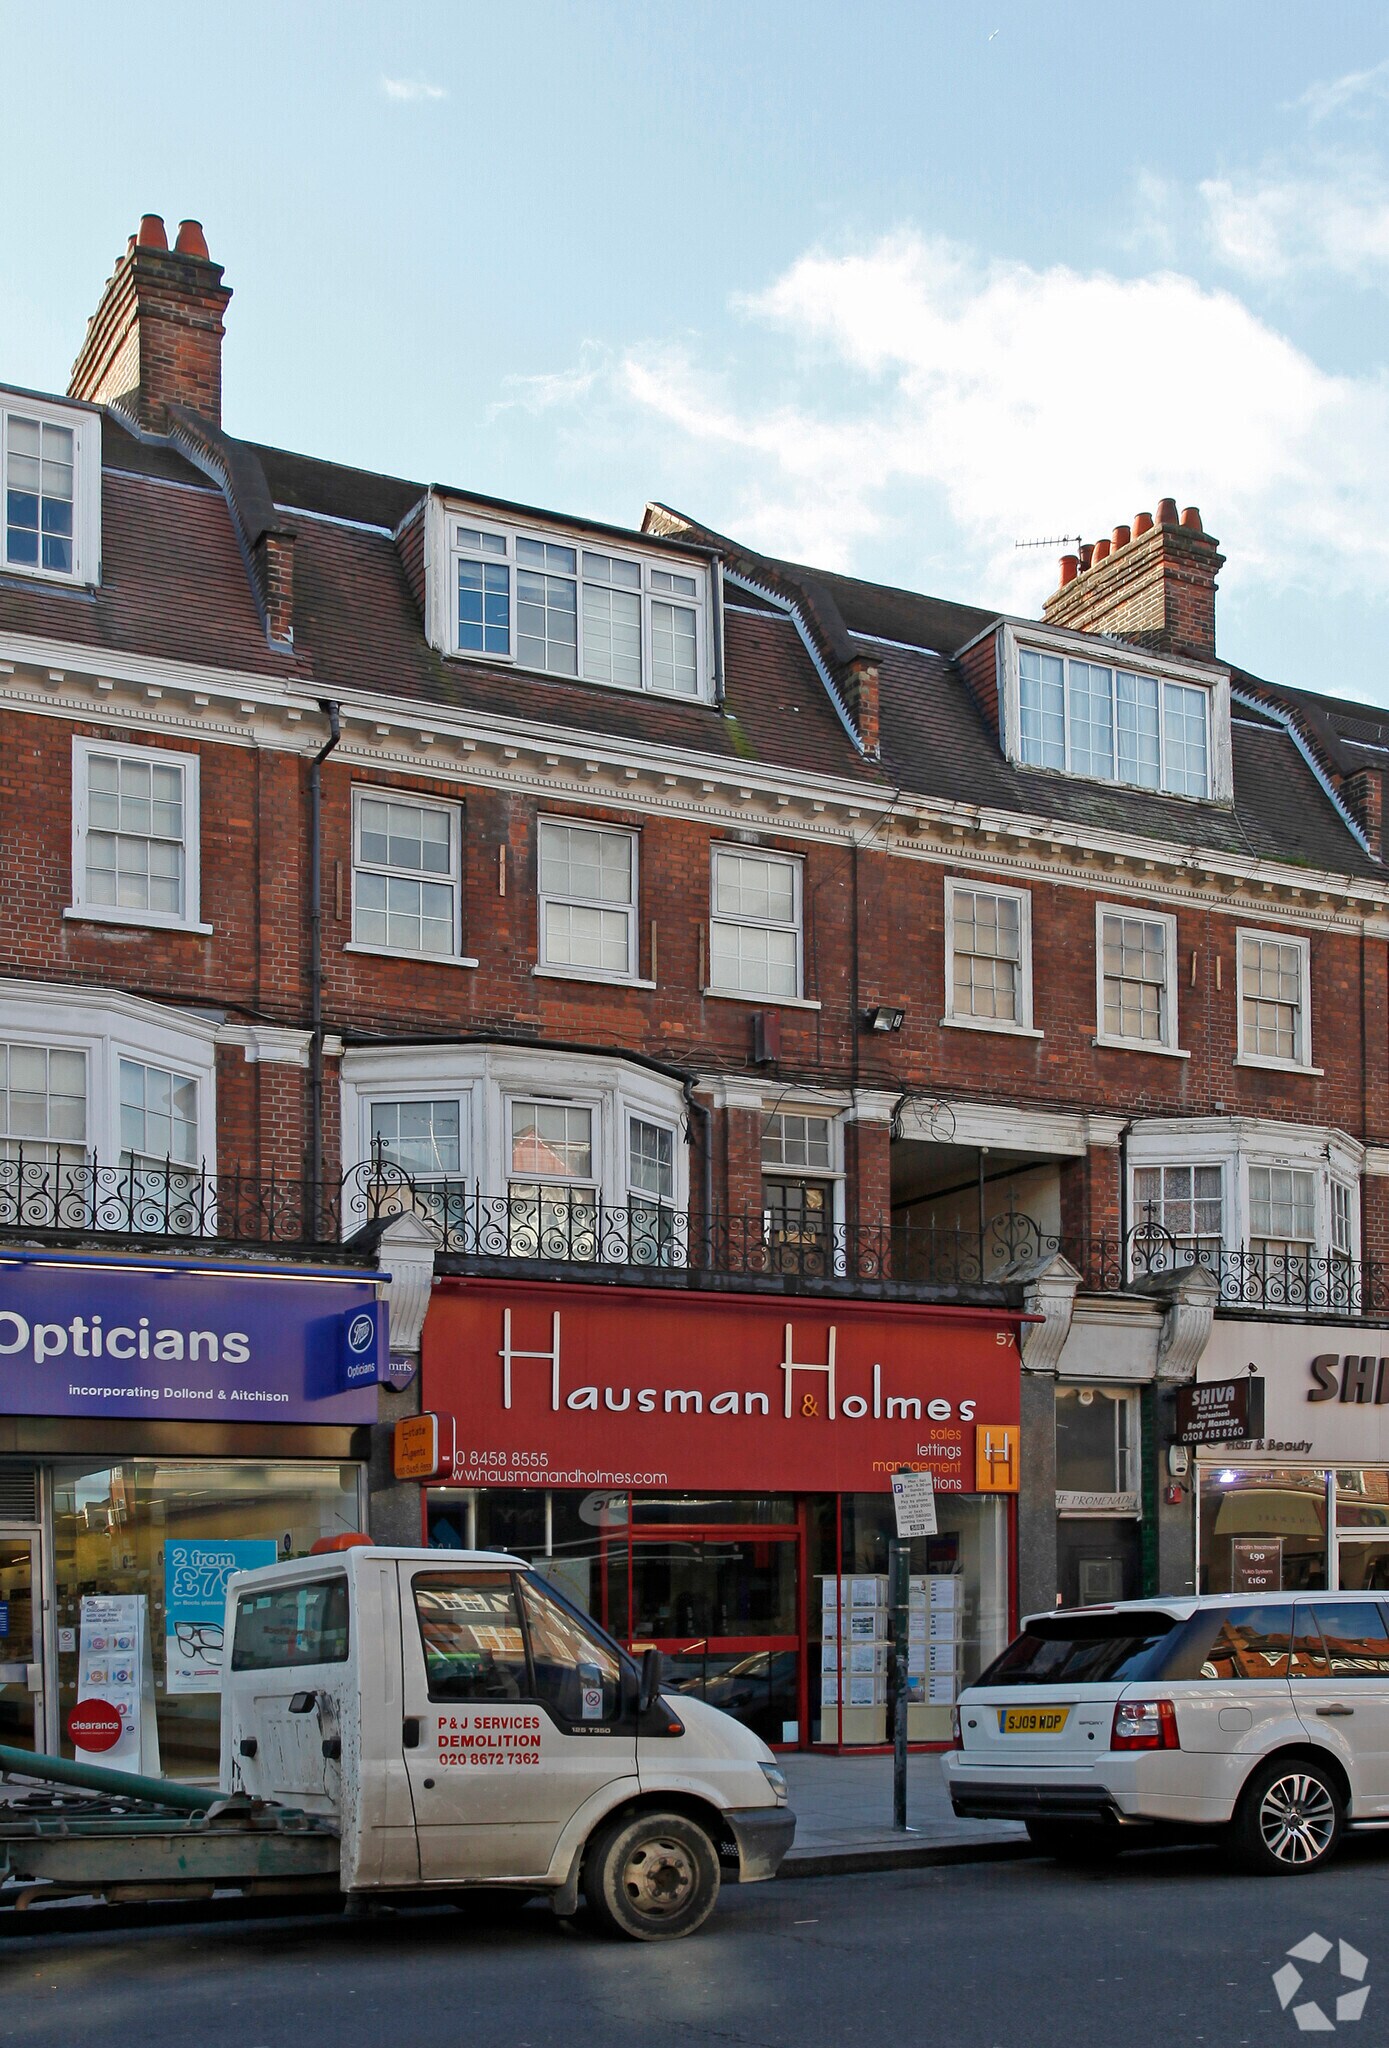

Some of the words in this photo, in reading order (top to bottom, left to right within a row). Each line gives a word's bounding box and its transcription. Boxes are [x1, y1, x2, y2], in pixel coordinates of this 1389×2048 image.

[0, 1311, 250, 1364] Opticians
[996, 1333, 1015, 1347] 57
[498, 1308, 769, 1414] Hausman
[348, 1363, 375, 1379] Opticians
[780, 1323, 977, 1420] Holmes
[69, 1385, 159, 1400] incorporating
[164, 1388, 213, 1399] Dollond
[217, 1390, 227, 1400] &
[230, 1390, 289, 1402] Aitchison
[1191, 1385, 1235, 1406] SHIVA
[802, 1394, 819, 1417] &
[1196, 1410, 1230, 1420] Professional
[402, 1421, 426, 1440] Estate
[1187, 1422, 1206, 1430] Body
[1207, 1418, 1239, 1428] Massage
[930, 1427, 962, 1440] sales
[1182, 1432, 1203, 1442] 0208
[1205, 1429, 1220, 1439] 455
[1222, 1427, 1244, 1437] 8260
[917, 1443, 962, 1459] lettings
[1225, 1440, 1254, 1451] Hair
[1255, 1439, 1265, 1451] &
[1267, 1439, 1314, 1454] Beauty
[470, 1451, 507, 1466] 8458
[512, 1452, 549, 1467] 8555
[872, 1461, 962, 1473] management
[895, 1484, 902, 1492] P
[1072, 1495, 1135, 1505] PROMENADE
[173, 1548, 187, 1566] 2
[191, 1550, 235, 1566] from
[1249, 1553, 1265, 1561] £90
[71, 1721, 119, 1730] clearance
[438, 1717, 447, 1729] P
[449, 1717, 457, 1729] &
[461, 1717, 468, 1729] J
[474, 1717, 540, 1729] SERVICES
[1008, 1716, 1036, 1729] SJ09
[1039, 1715, 1062, 1729] WDP
[438, 1735, 541, 1747] DEMOLITION
[440, 1753, 467, 1765] 020
[470, 1753, 504, 1765] 8672
[507, 1753, 540, 1765] 7362
